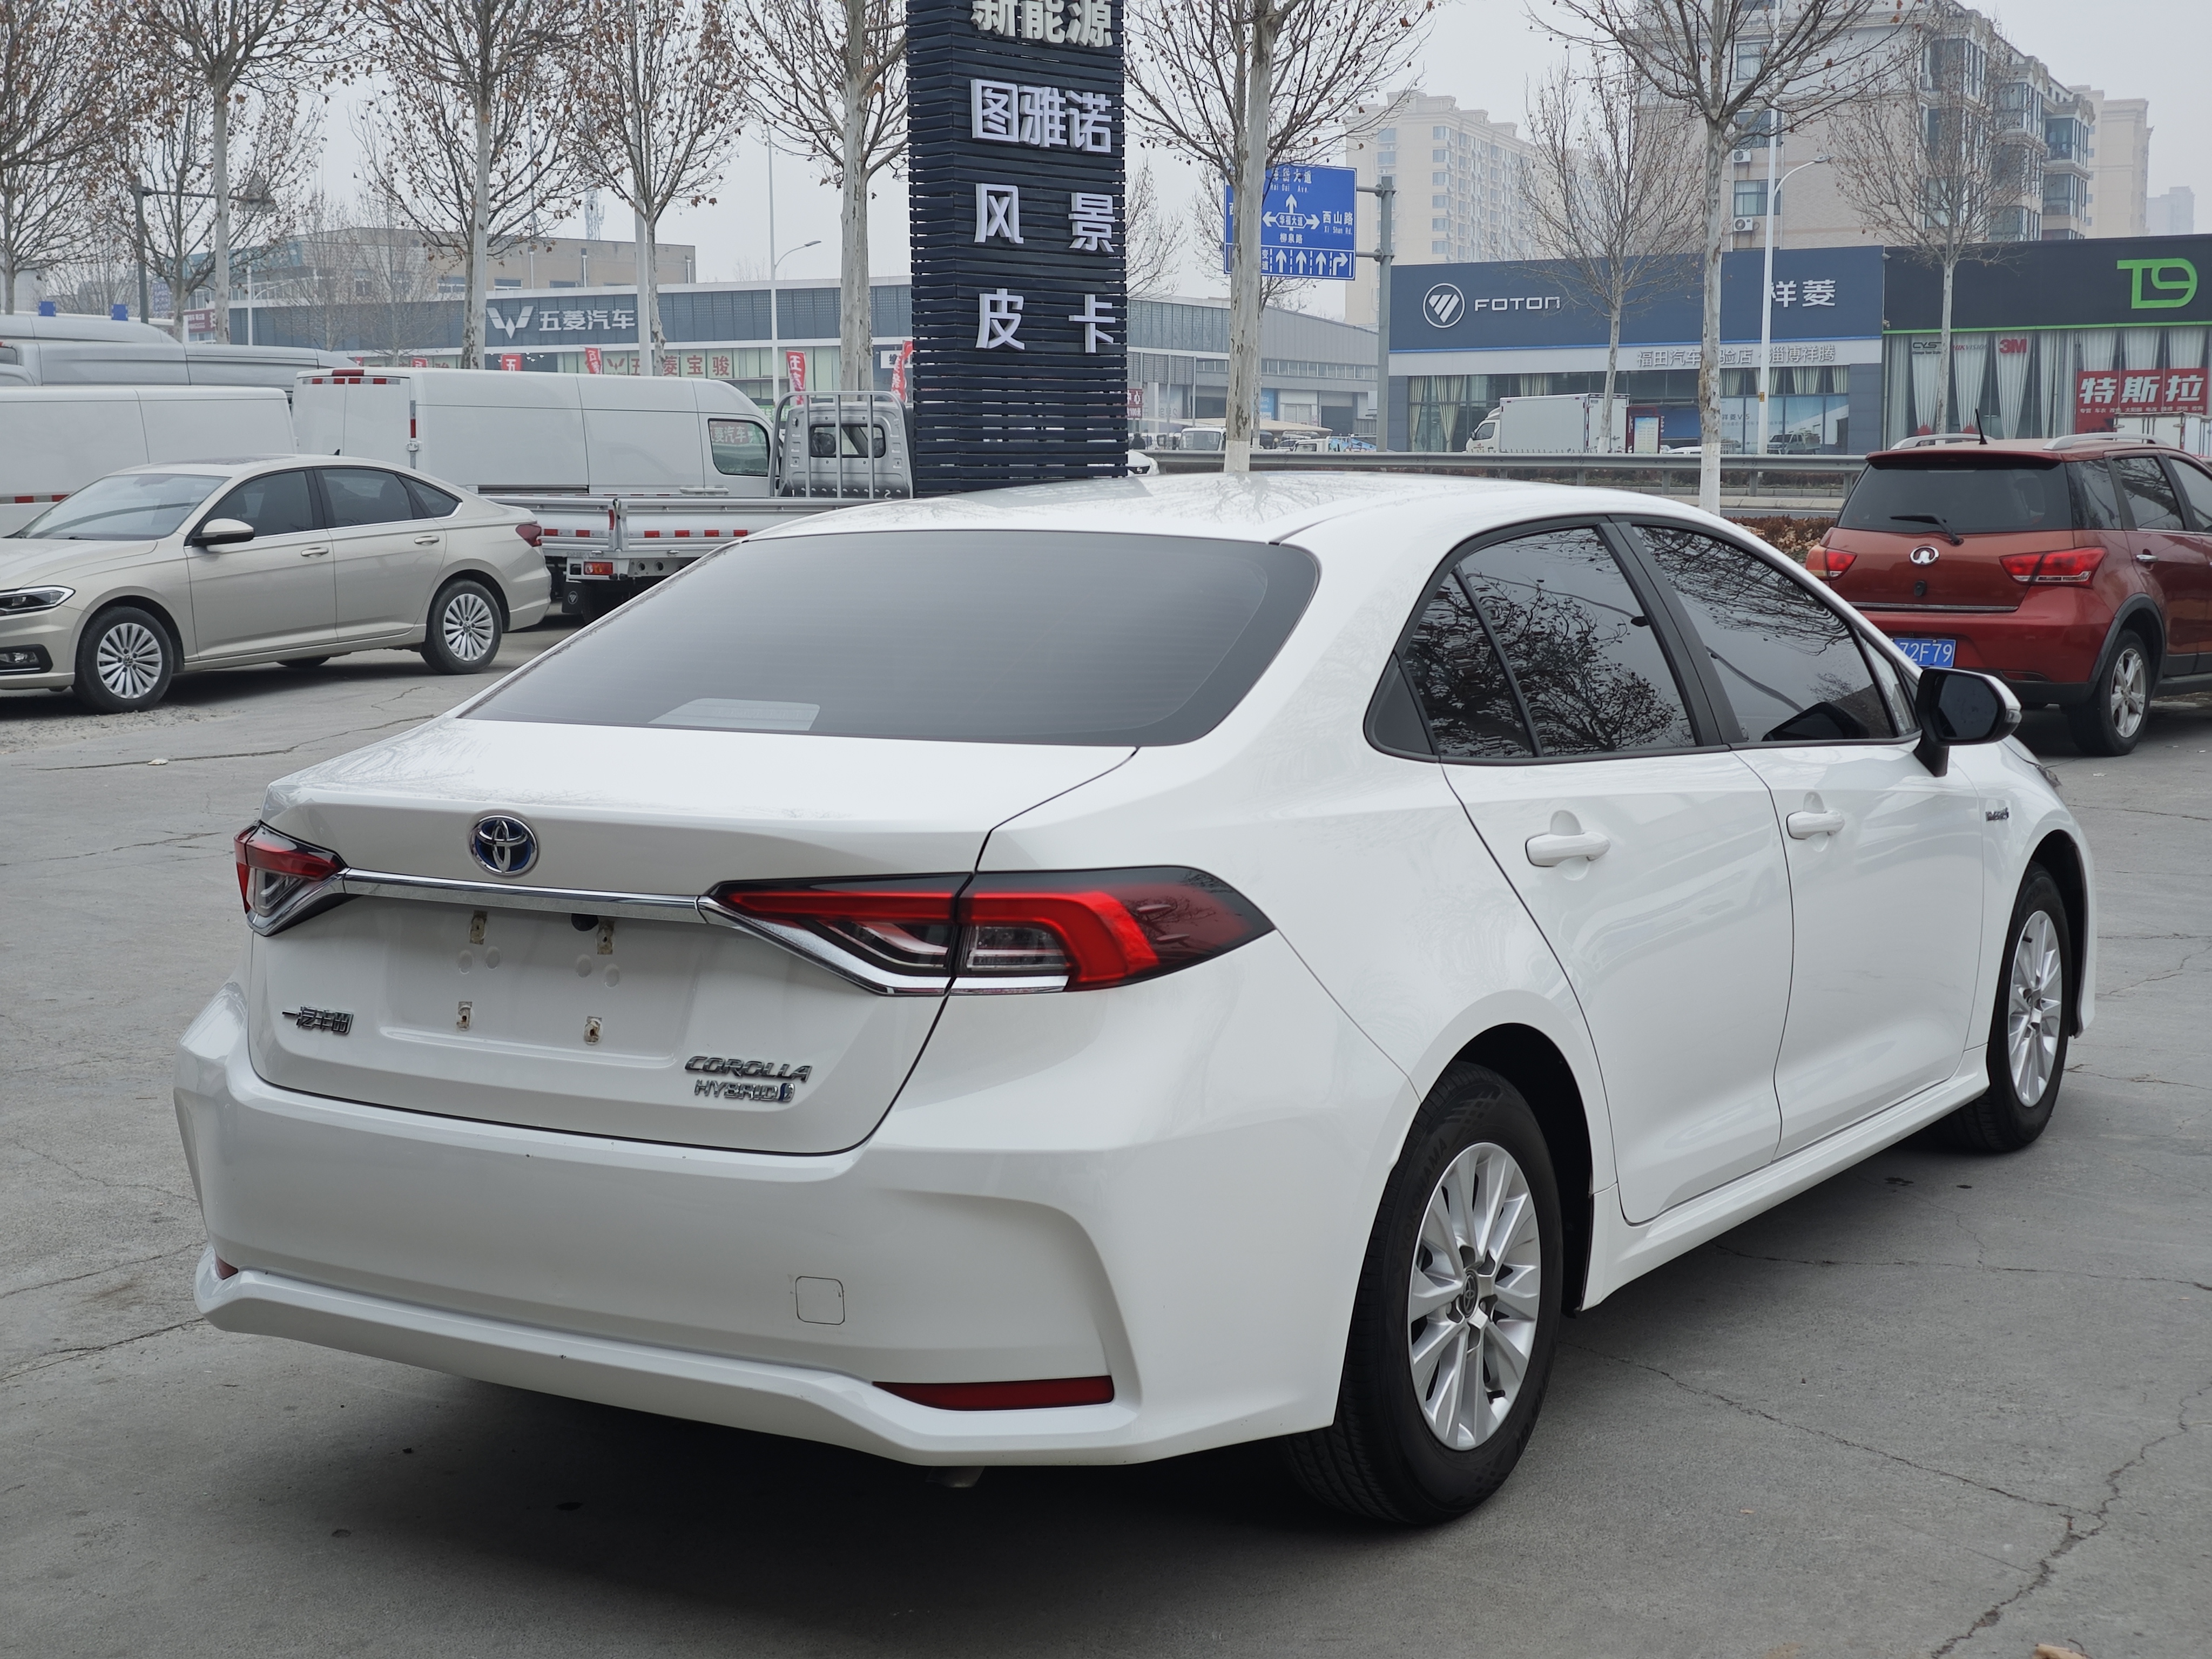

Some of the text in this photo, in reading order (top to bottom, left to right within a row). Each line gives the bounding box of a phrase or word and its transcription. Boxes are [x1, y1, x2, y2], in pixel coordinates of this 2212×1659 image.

[970, 0, 1113, 48] 新能源
[970, 79, 1112, 153] 图雅诺
[974, 183, 1115, 253] 风景
[1322, 210, 1353, 226] 西山路
[1332, 226, 1343, 234] Shan
[1279, 232, 1303, 244] 柳泉路
[1474, 296, 1560, 312] FOTON
[1771, 279, 1836, 308] 祥菱
[538, 308, 636, 332] 五菱汽车
[975, 288, 1116, 353] 皮卡
[1636, 347, 1754, 367] 福田汽车验店
[1999, 338, 2027, 354] 3M
[2079, 374, 2204, 404] 特斯拉
[684, 1055, 813, 1083] COROLLA
[694, 1079, 779, 1102] HYBRID
